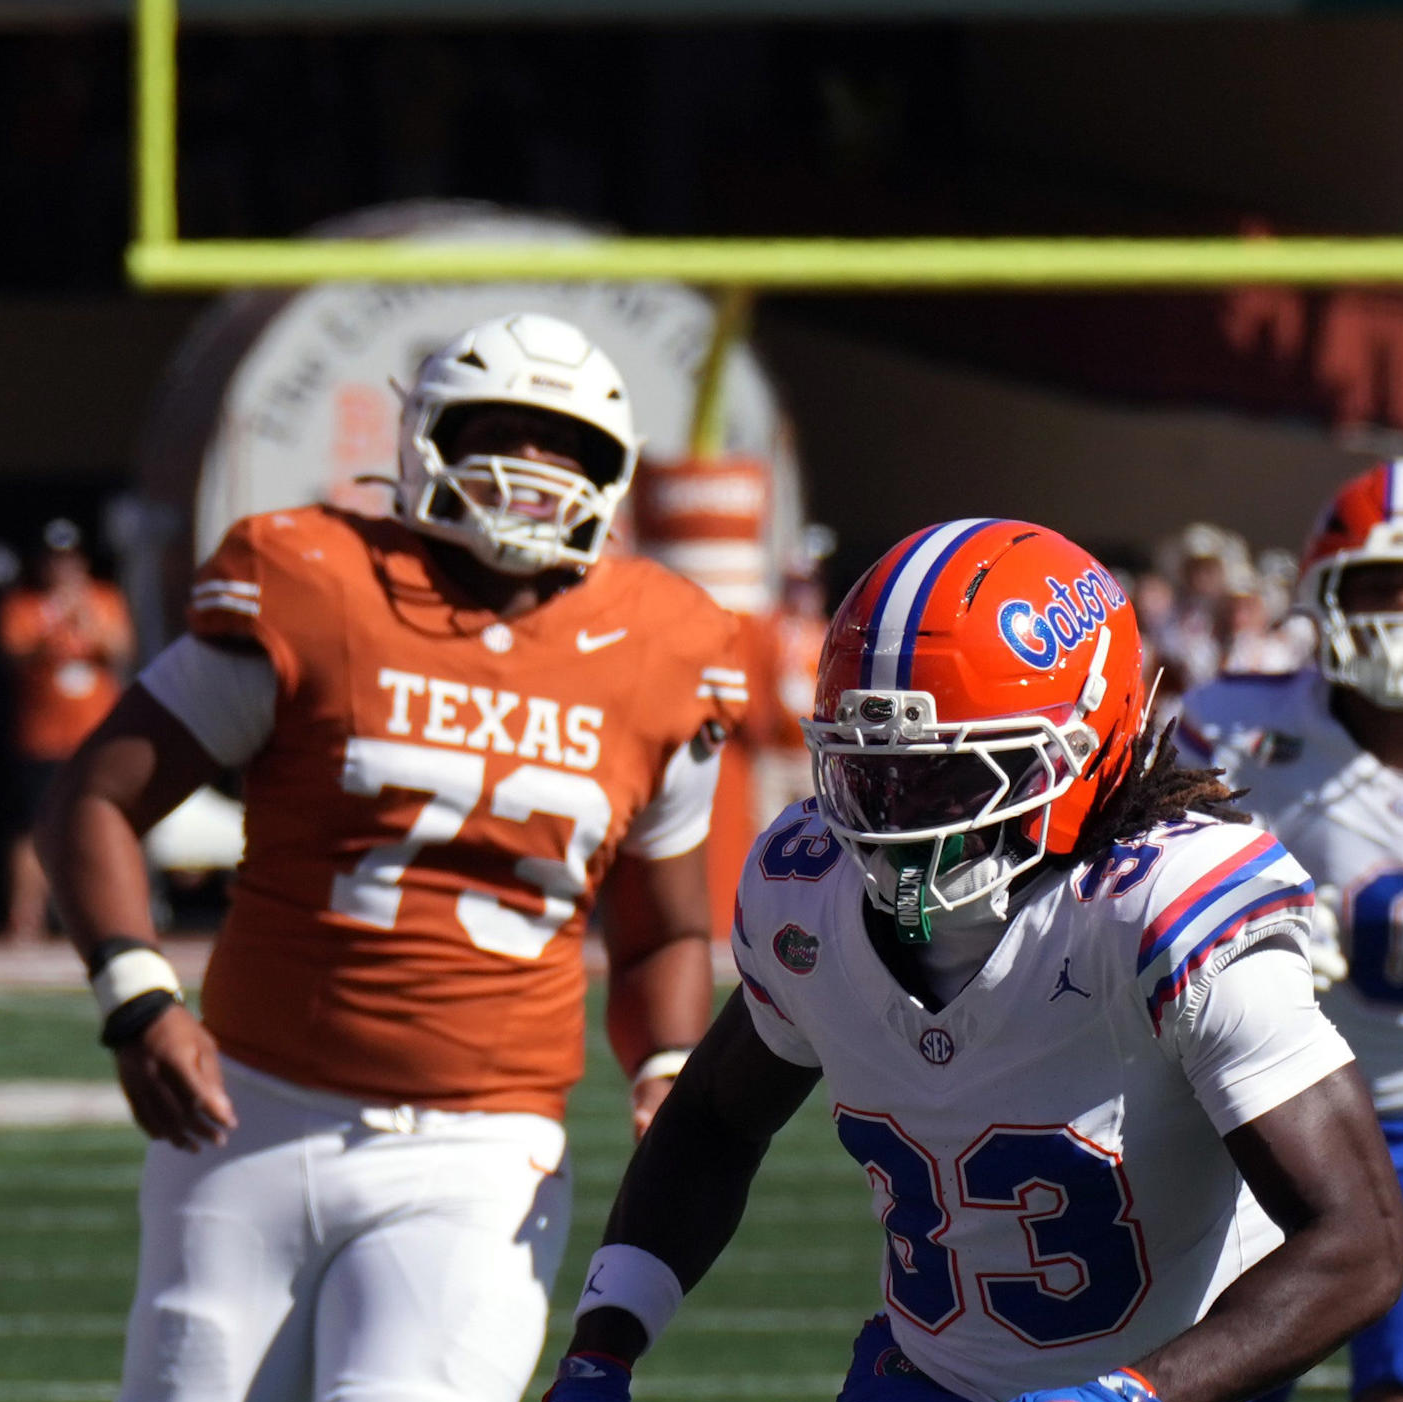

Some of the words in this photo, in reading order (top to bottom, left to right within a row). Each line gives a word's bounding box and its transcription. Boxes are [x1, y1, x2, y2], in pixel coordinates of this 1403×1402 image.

[998, 561, 1126, 670] Gators
[378, 668, 603, 770] TEXAS
[329, 736, 612, 959] 73
[897, 868, 921, 926] NXTRND
[921, 1030, 952, 1062] SEC
[833, 1102, 1152, 1348] 33
